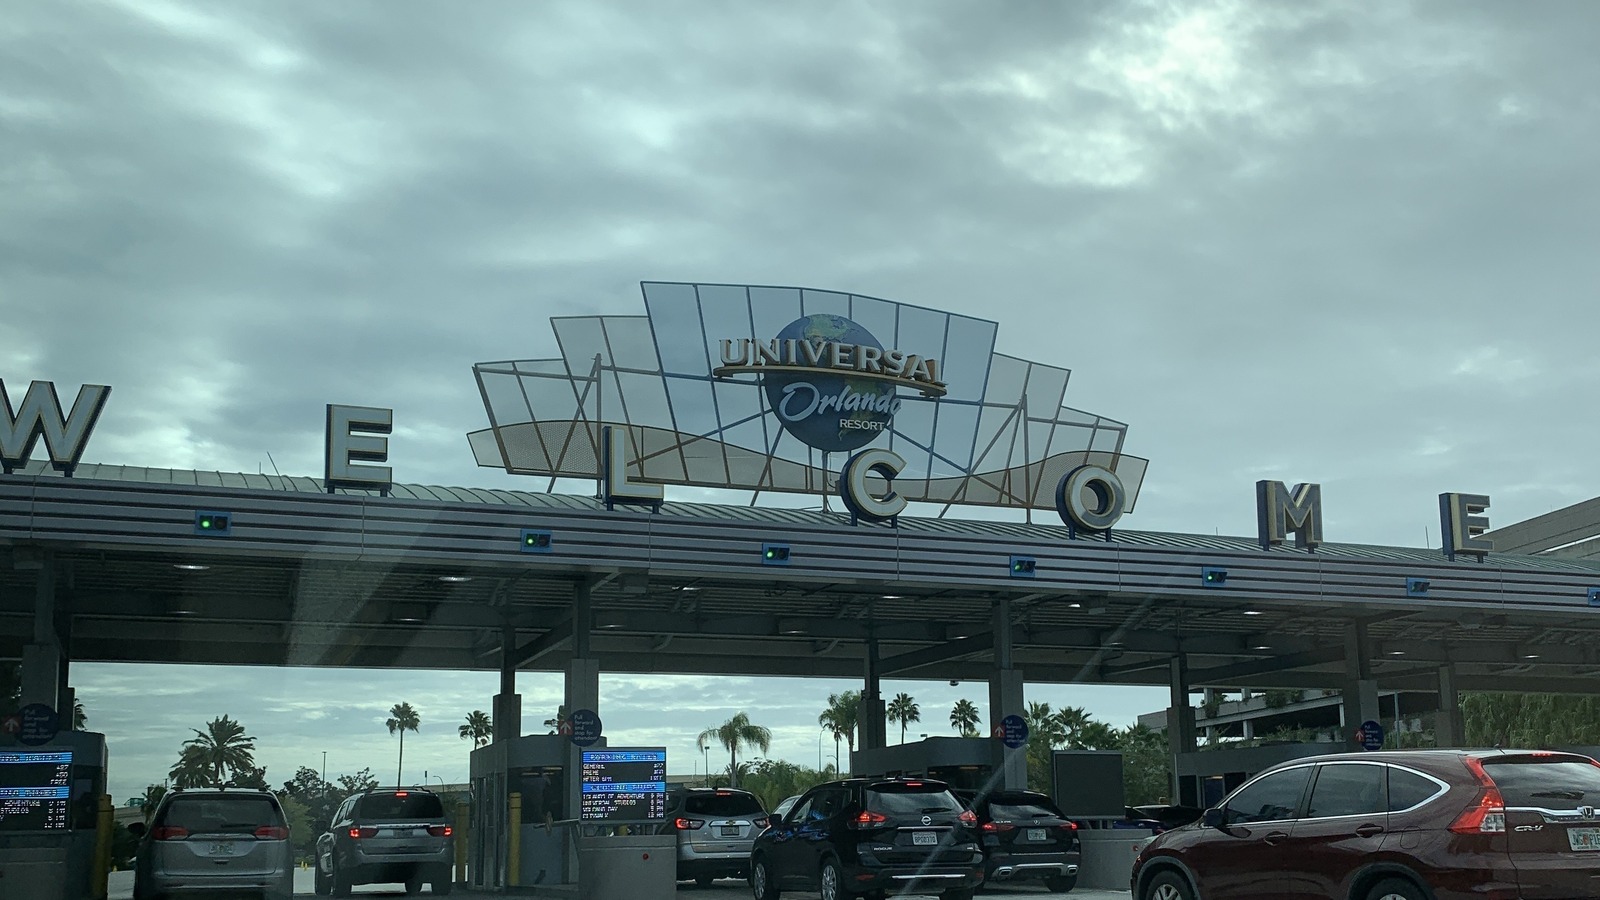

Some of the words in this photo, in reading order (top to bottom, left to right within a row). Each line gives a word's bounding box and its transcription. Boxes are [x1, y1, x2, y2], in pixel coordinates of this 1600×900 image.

[719, 338, 948, 388] UNIVERSAL
[779, 381, 901, 421] Orlando
[839, 418, 885, 431] RESORT
